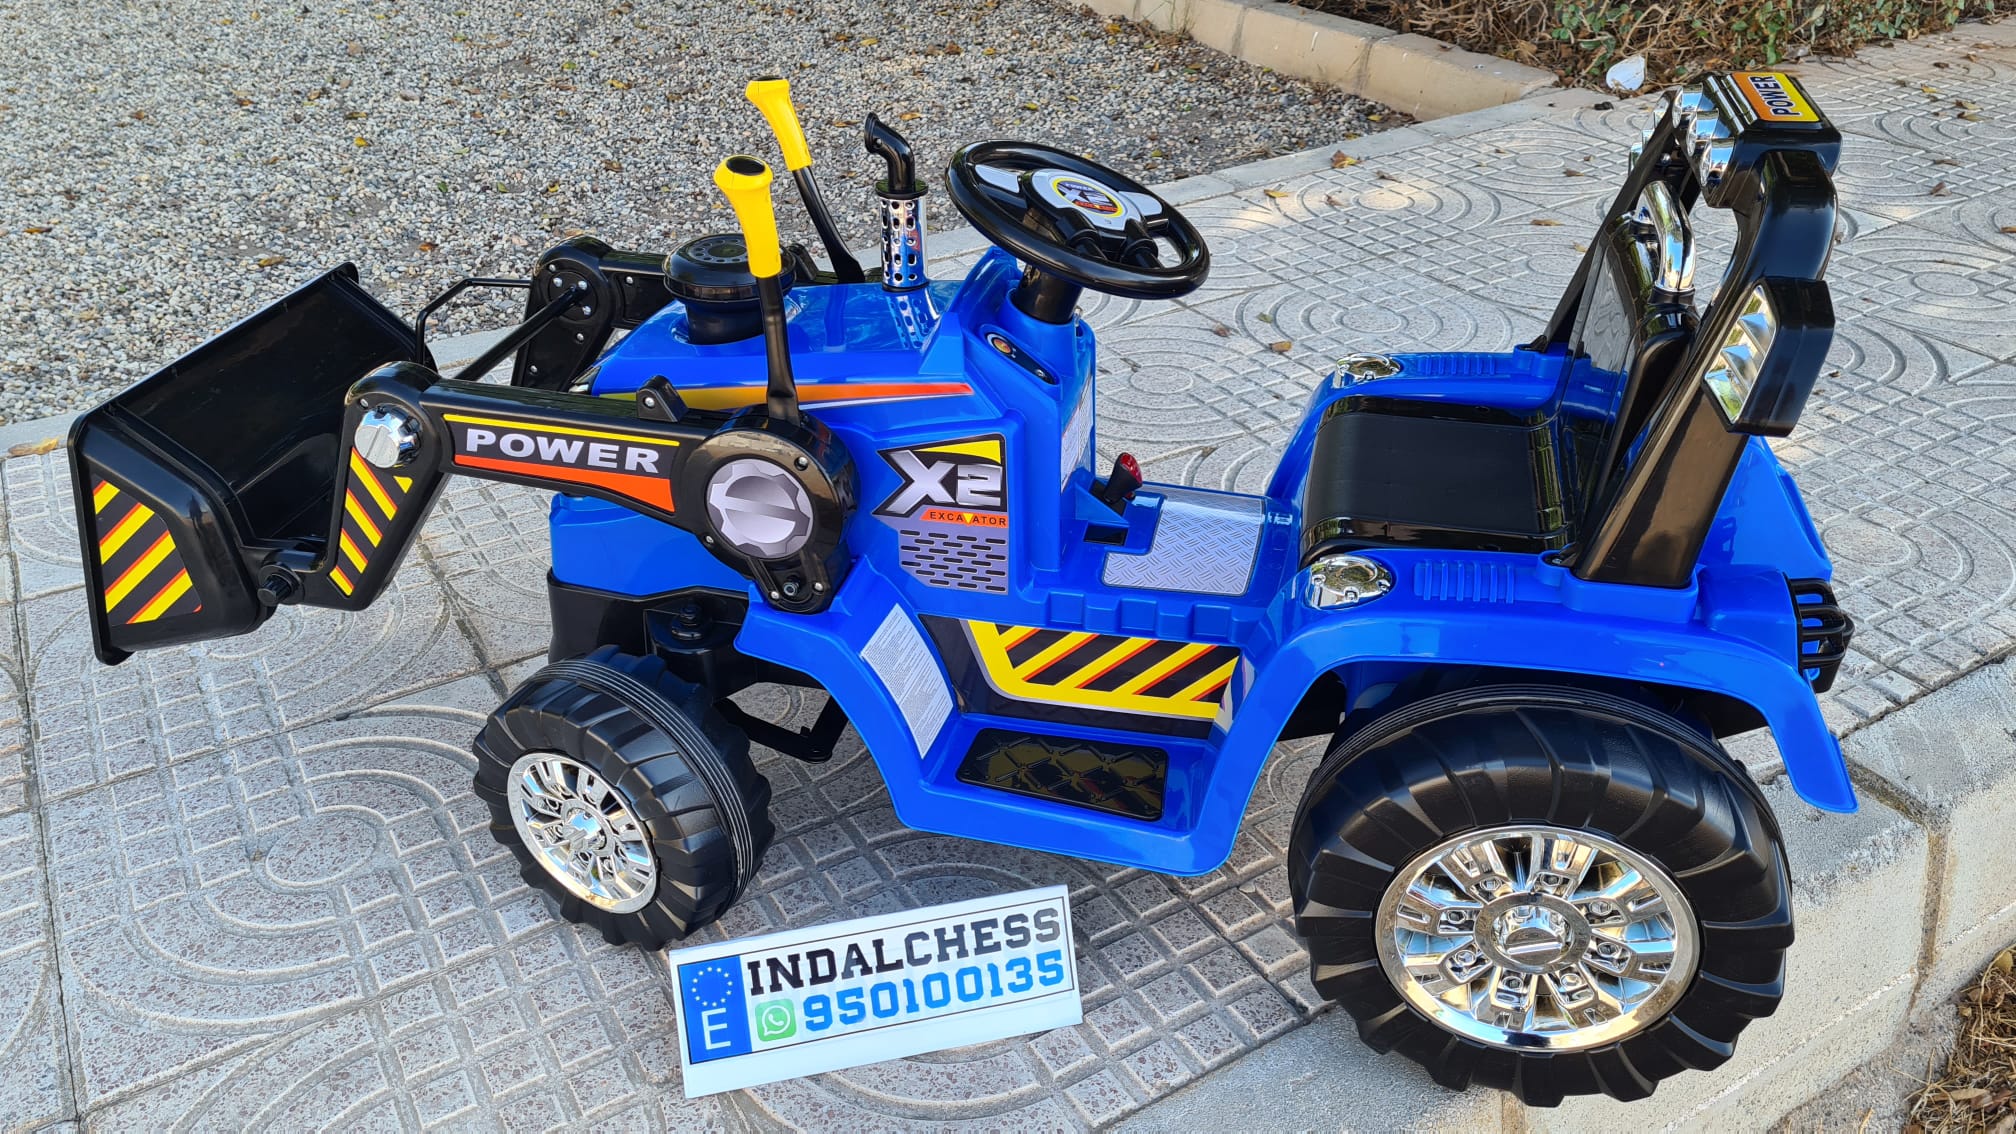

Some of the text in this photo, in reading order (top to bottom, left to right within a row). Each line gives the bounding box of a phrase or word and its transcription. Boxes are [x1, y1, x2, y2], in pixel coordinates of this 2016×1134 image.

[1749, 76, 1802, 116] POWER
[466, 428, 659, 474] POWER
[885, 449, 1003, 515] X2
[929, 511, 1007, 526] EXCAVATOR
[747, 908, 1060, 996] INDALCHESS
[804, 949, 1063, 1032] 950100135
[701, 1007, 732, 1050] E
